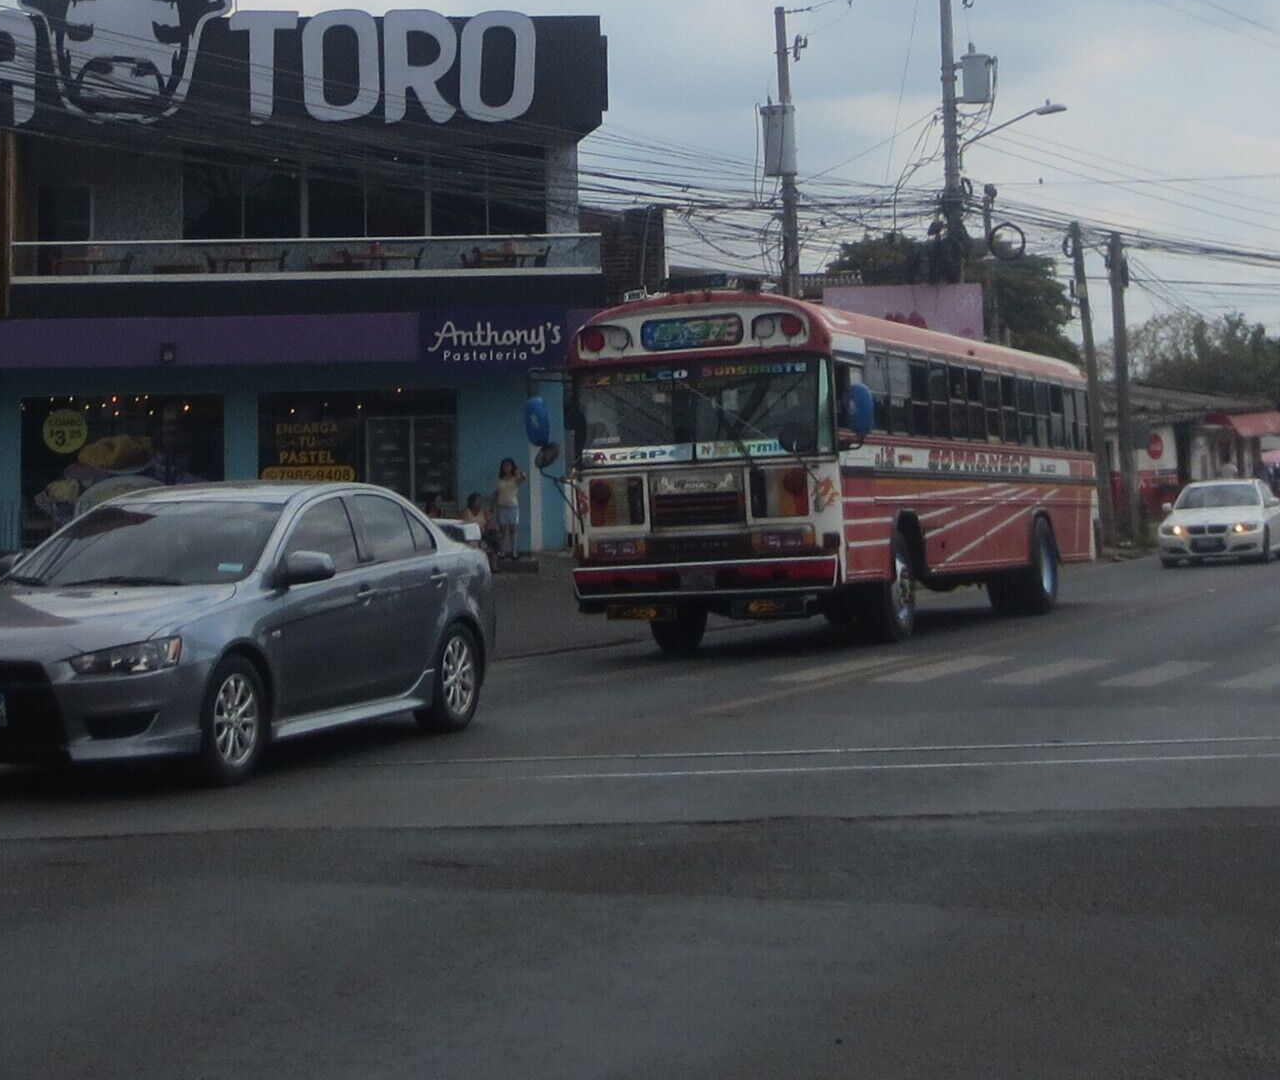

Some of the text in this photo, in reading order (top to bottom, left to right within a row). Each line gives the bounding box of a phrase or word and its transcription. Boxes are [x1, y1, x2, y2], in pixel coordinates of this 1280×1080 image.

[228, 8, 537, 124] TORO
[426, 320, 562, 356] Anthony's
[276, 422, 340, 436] ENCARGA
[279, 450, 337, 465] PASTEL
